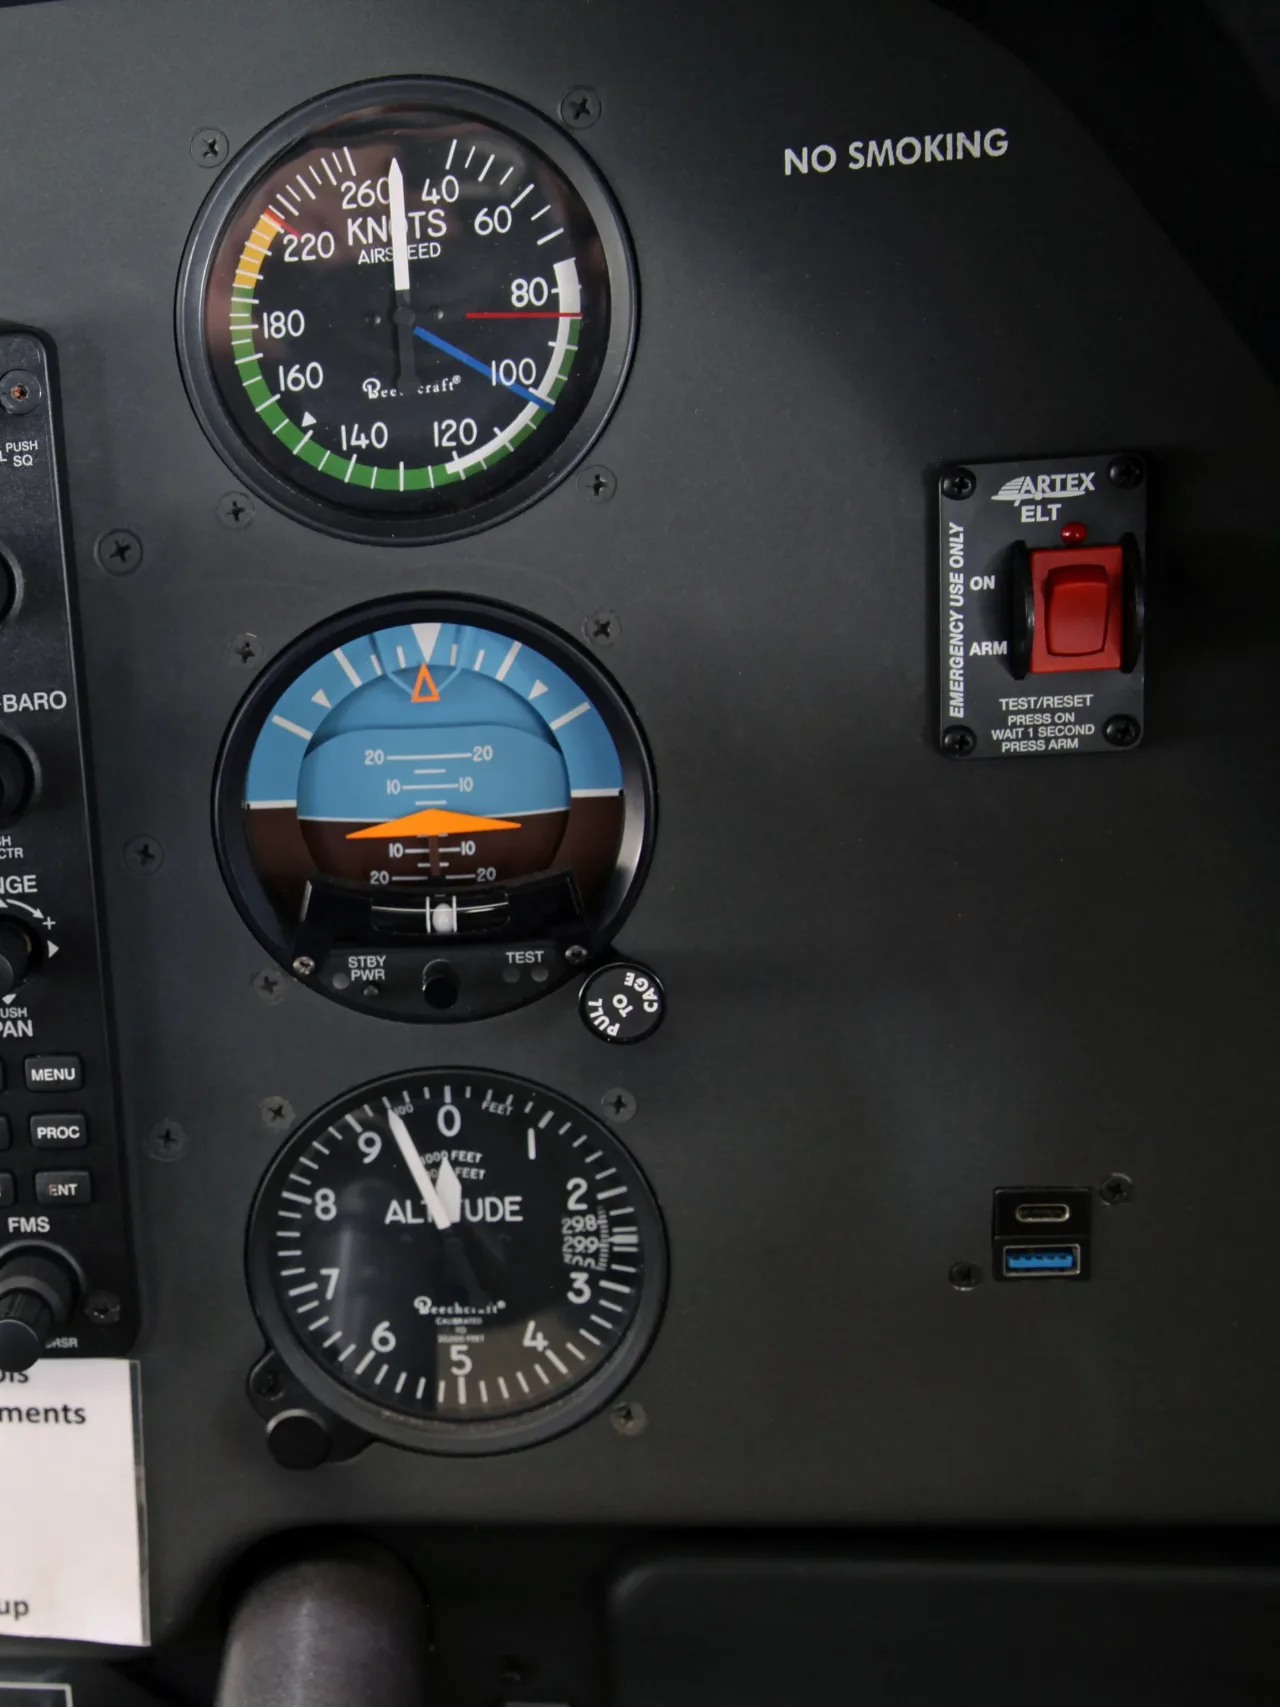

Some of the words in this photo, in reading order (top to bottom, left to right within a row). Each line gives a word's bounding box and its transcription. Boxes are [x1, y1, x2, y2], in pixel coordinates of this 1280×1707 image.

[785, 145, 837, 175] NO
[849, 128, 1008, 170] SMOKING
[341, 177, 390, 210] 260
[422, 175, 459, 203] 40
[348, 210, 446, 246] KNTS
[474, 206, 512, 235] 60
[284, 233, 335, 261] 220
[358, 243, 441, 265] AIRSEED
[511, 278, 548, 307] 80
[262, 310, 305, 339] 180
[279, 362, 323, 391] 160
[491, 358, 536, 386] 100
[340, 422, 388, 450] 140
[434, 418, 477, 447] 120
[6, 441, 38, 452] PUSH
[13, 454, 33, 467] SQ
[1020, 472, 1095, 494] ARTEX
[1021, 504, 1062, 522] ELT
[949, 522, 964, 568] ONLY
[950, 573, 964, 609] USE
[970, 575, 995, 590] ON
[969, 641, 1008, 656] ARM
[950, 611, 964, 718] EMERGENCY
[2, 691, 67, 713] BARO
[999, 694, 1093, 711] TEST/RESET
[1008, 712, 1051, 726] PRESS
[1054, 712, 1075, 724] ON
[992, 728, 1024, 740] WAIT
[1028, 728, 1033, 737] 1
[1037, 724, 1095, 736] SECOND
[473, 745, 493, 761] 20
[1002, 740, 1046, 752] PRESS
[1048, 738, 1078, 750] ARM
[365, 750, 384, 765] 20
[387, 780, 401, 794] 10
[459, 777, 473, 792] 10
[389, 843, 403, 858] 10
[461, 841, 476, 855] 10
[370, 871, 389, 885] 20
[477, 868, 496, 882] 20
[348, 956, 386, 968] STBY
[506, 951, 544, 964] TEST
[350, 970, 385, 981] PWR
[588, 998, 621, 1036] PULL
[612, 994, 633, 1018] TO
[624, 972, 658, 1012] CAGE
[31, 1068, 76, 1081] MENU
[437, 1105, 461, 1137] 0
[37, 1126, 80, 1139] PROC
[358, 1131, 382, 1164] 9
[451, 1150, 482, 1163] FEET
[49, 1183, 78, 1196] ENT
[566, 1178, 587, 1210] 2
[314, 1188, 337, 1221] 8
[8, 1216, 50, 1233] FMS
[320, 1269, 340, 1299] 7
[568, 1272, 591, 1303] 3
[371, 1321, 396, 1352] 6
[522, 1321, 548, 1351] 4
[449, 1345, 472, 1376] 5
